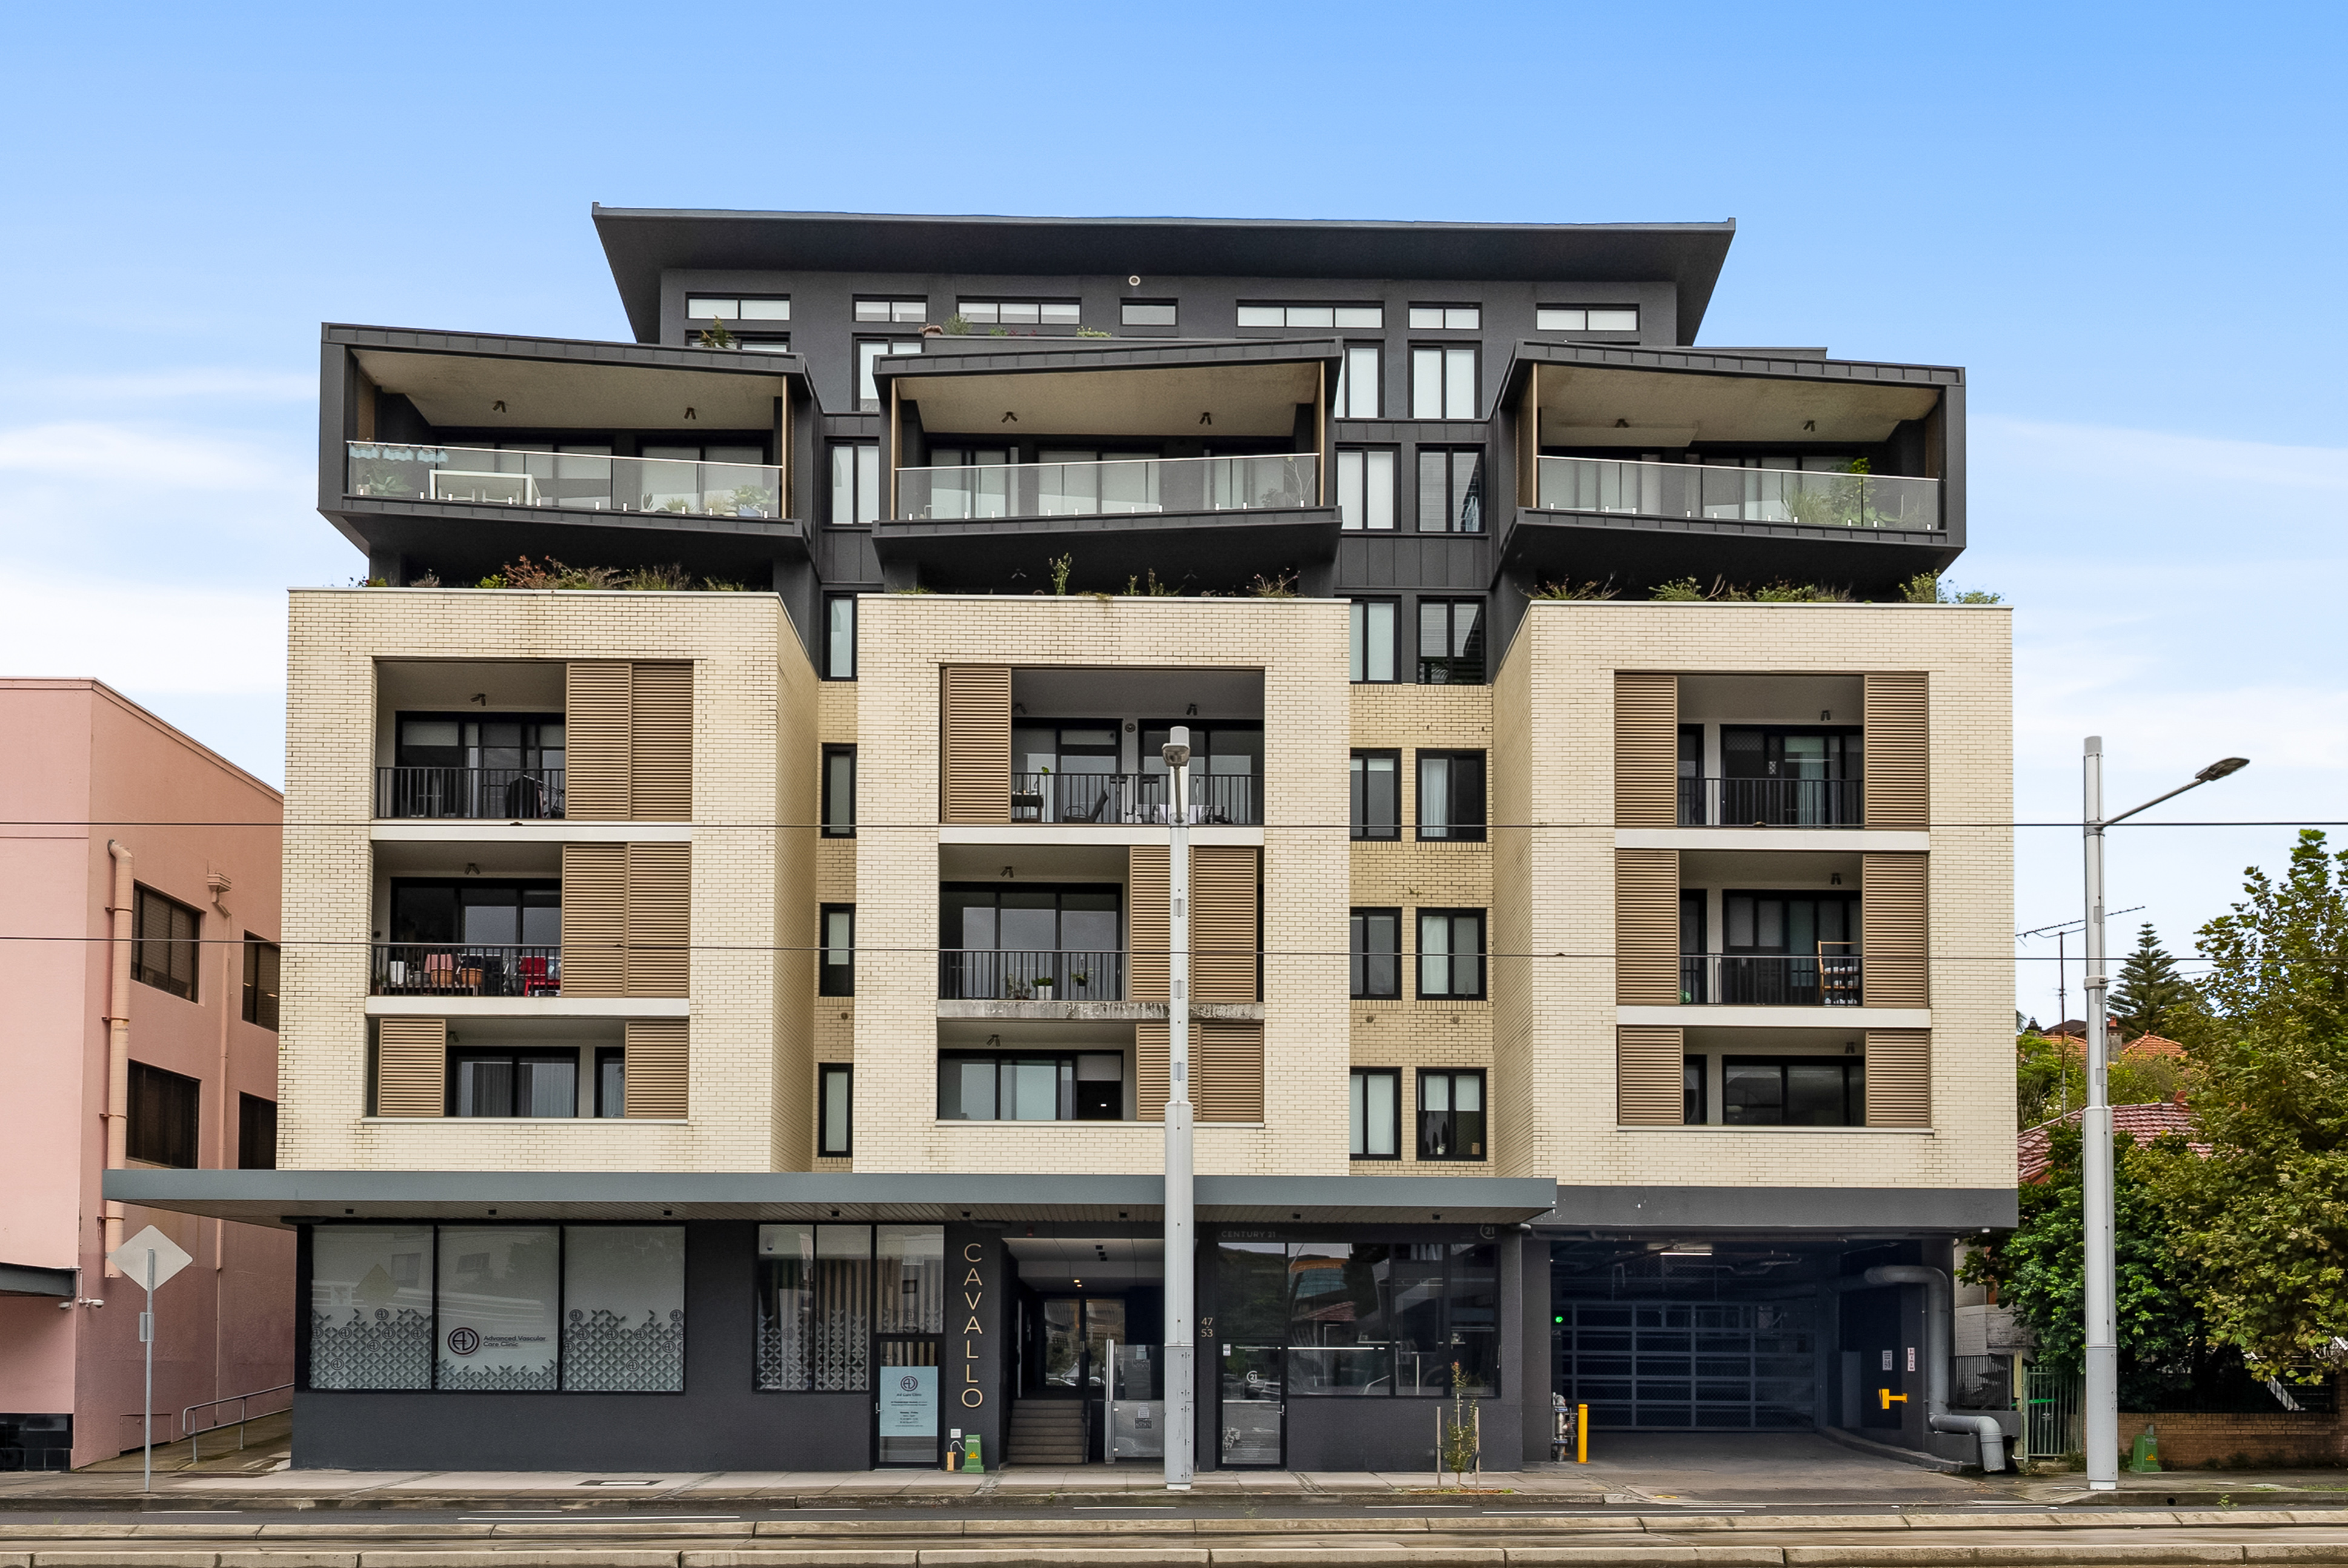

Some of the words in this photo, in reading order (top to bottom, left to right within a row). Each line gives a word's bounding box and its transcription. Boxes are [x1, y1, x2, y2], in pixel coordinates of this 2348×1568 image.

[962, 1243, 983, 1407] CAVALLO
[1201, 1317, 1213, 1326] 47
[1201, 1329, 1213, 1337] 53
